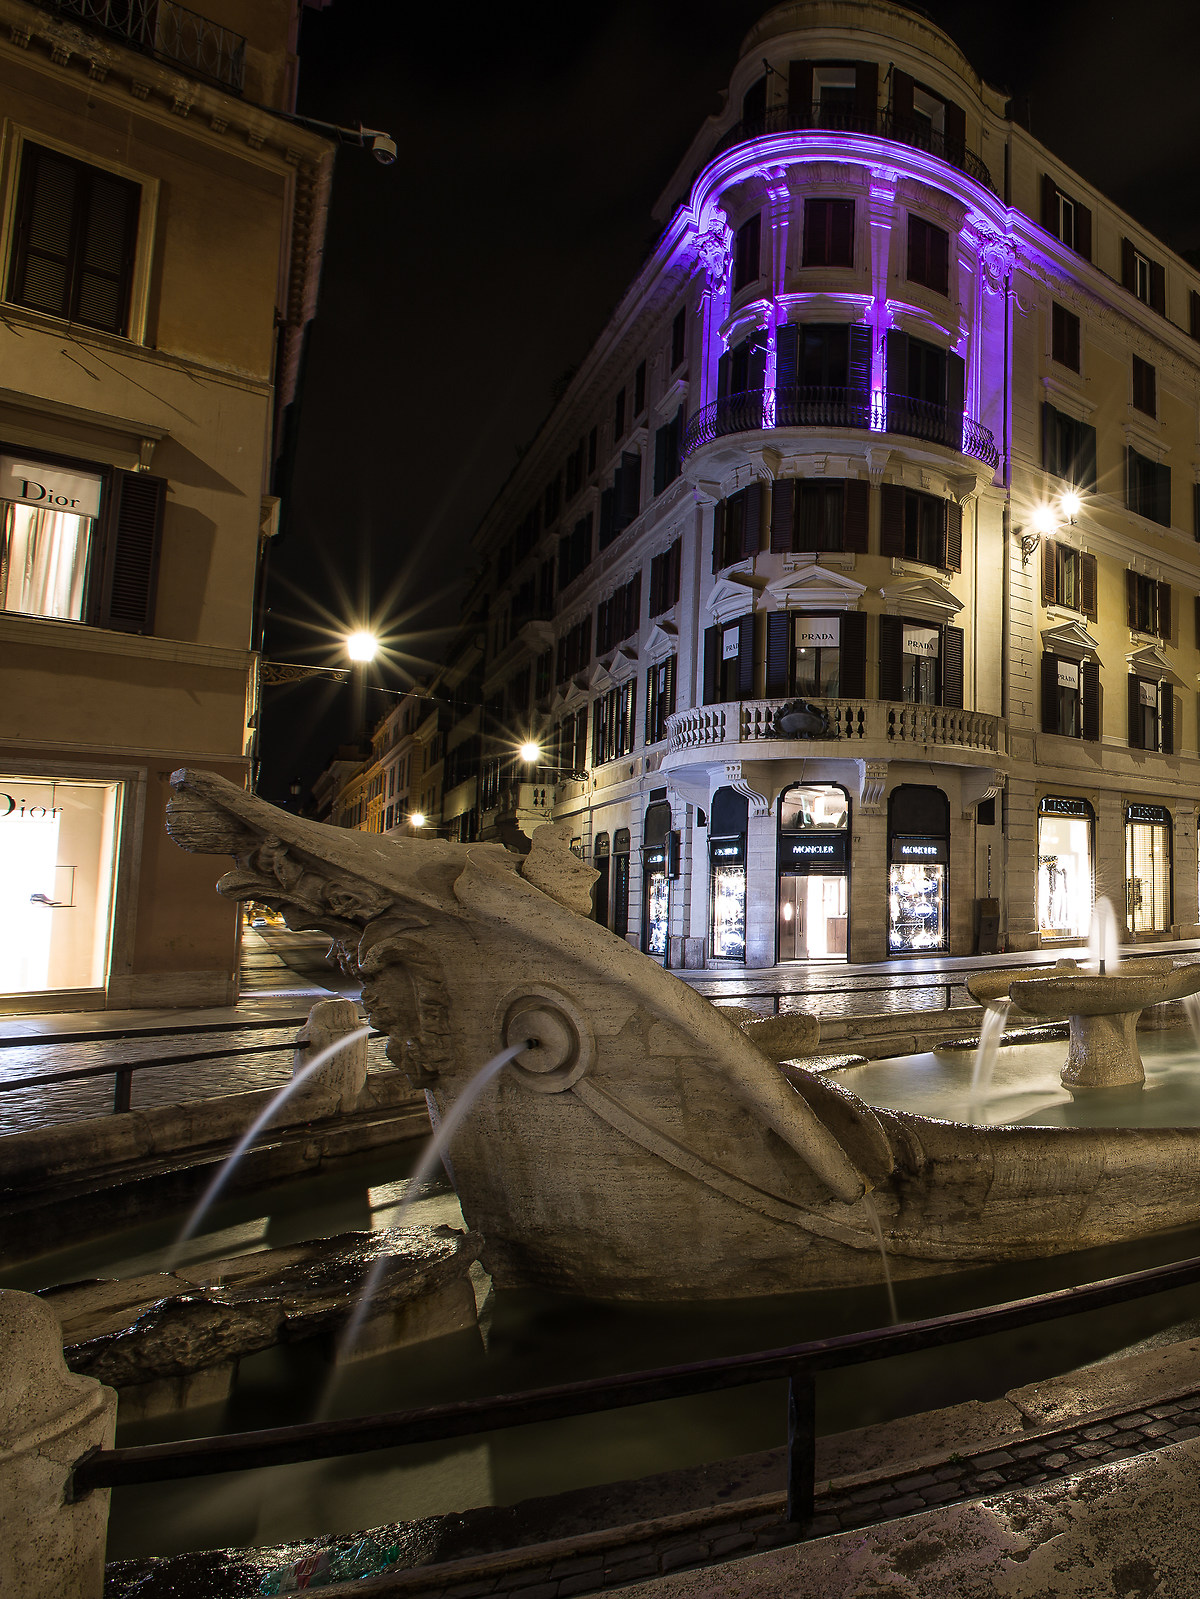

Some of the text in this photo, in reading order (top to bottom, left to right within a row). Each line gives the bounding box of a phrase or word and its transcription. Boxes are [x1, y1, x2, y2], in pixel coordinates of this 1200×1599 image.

[17, 478, 81, 508] Dior
[725, 642, 740, 652] PRAD
[907, 639, 934, 651] PRADA
[792, 845, 834, 854] MONCLER
